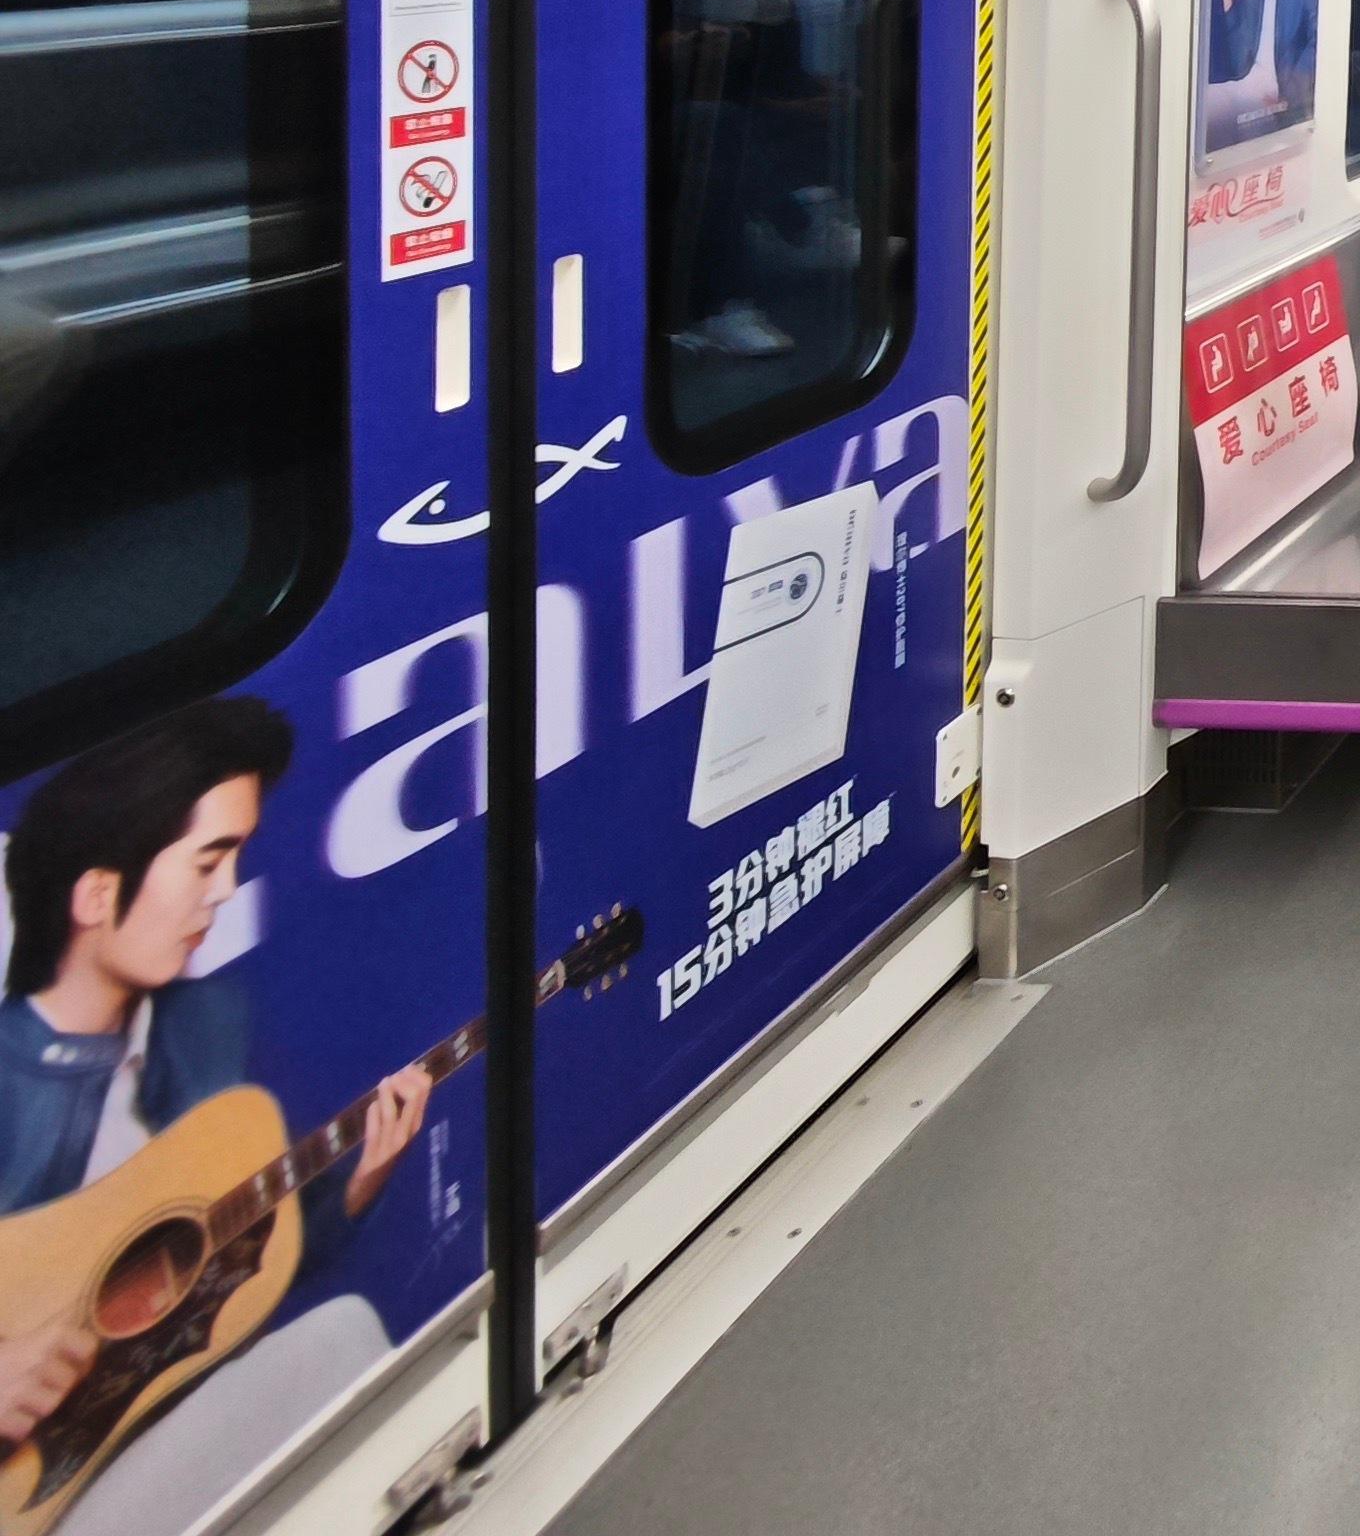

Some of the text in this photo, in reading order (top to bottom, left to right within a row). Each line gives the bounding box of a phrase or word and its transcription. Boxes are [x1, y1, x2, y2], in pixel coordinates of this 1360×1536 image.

[1217, 355, 1340, 465] 爱心座椅
[1251, 412, 1319, 467] Courtesy Seat
